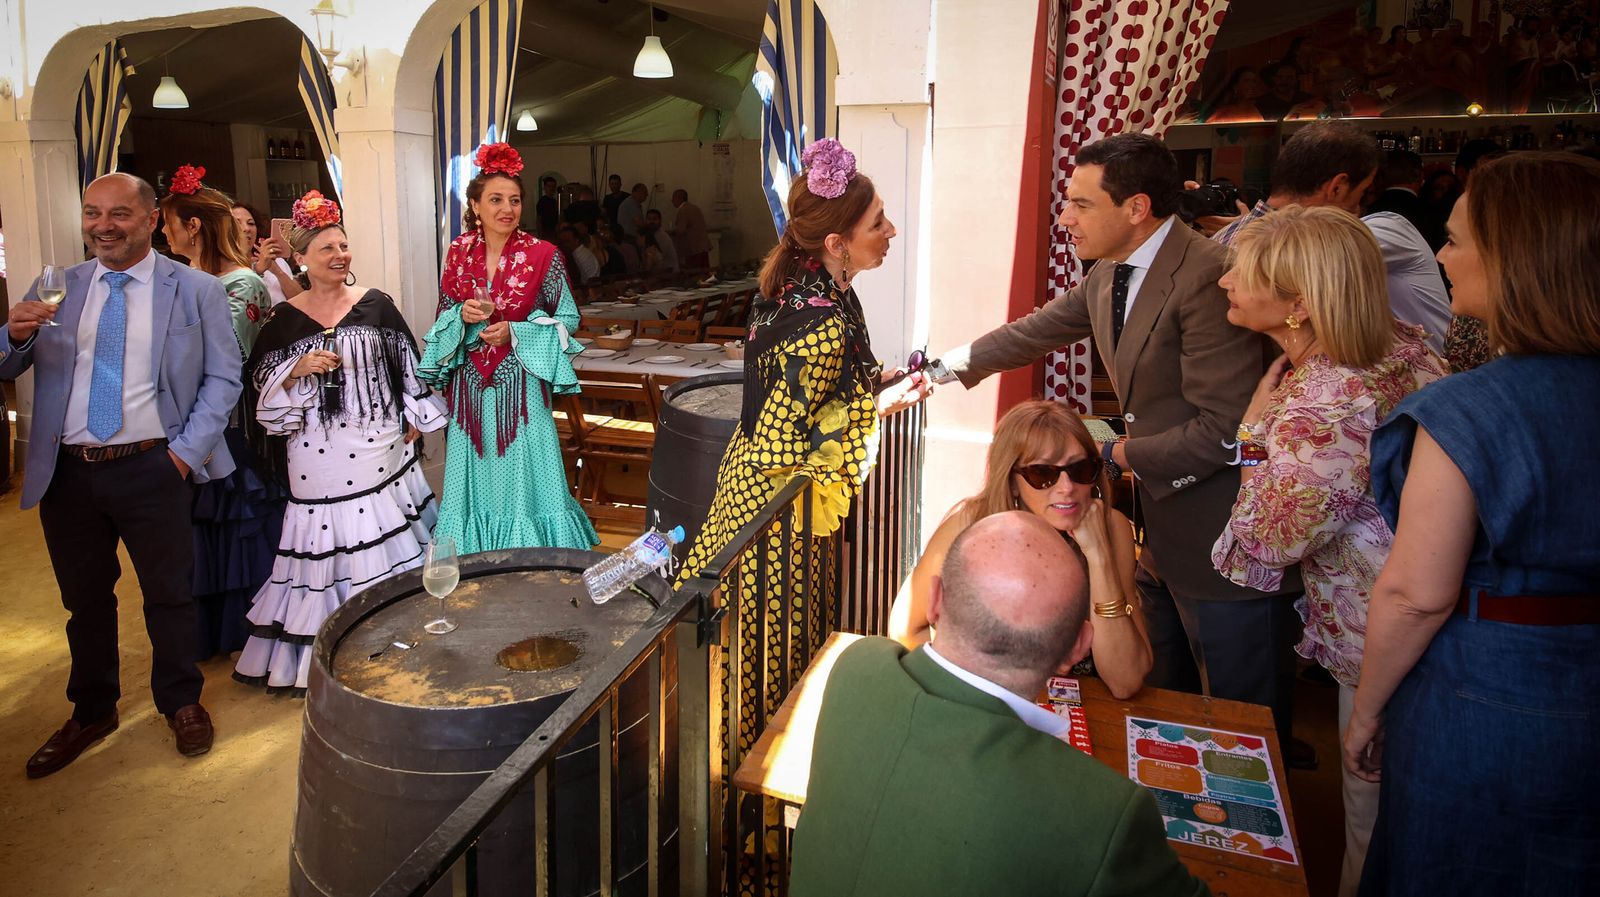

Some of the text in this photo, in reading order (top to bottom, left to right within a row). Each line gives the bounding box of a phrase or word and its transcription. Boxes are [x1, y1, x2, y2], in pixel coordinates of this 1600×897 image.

[1215, 751, 1253, 761] Entrantes
[1155, 761, 1181, 771] Fritos
[1183, 793, 1222, 806] Bebidas
[1178, 831, 1249, 852] JEREZ
